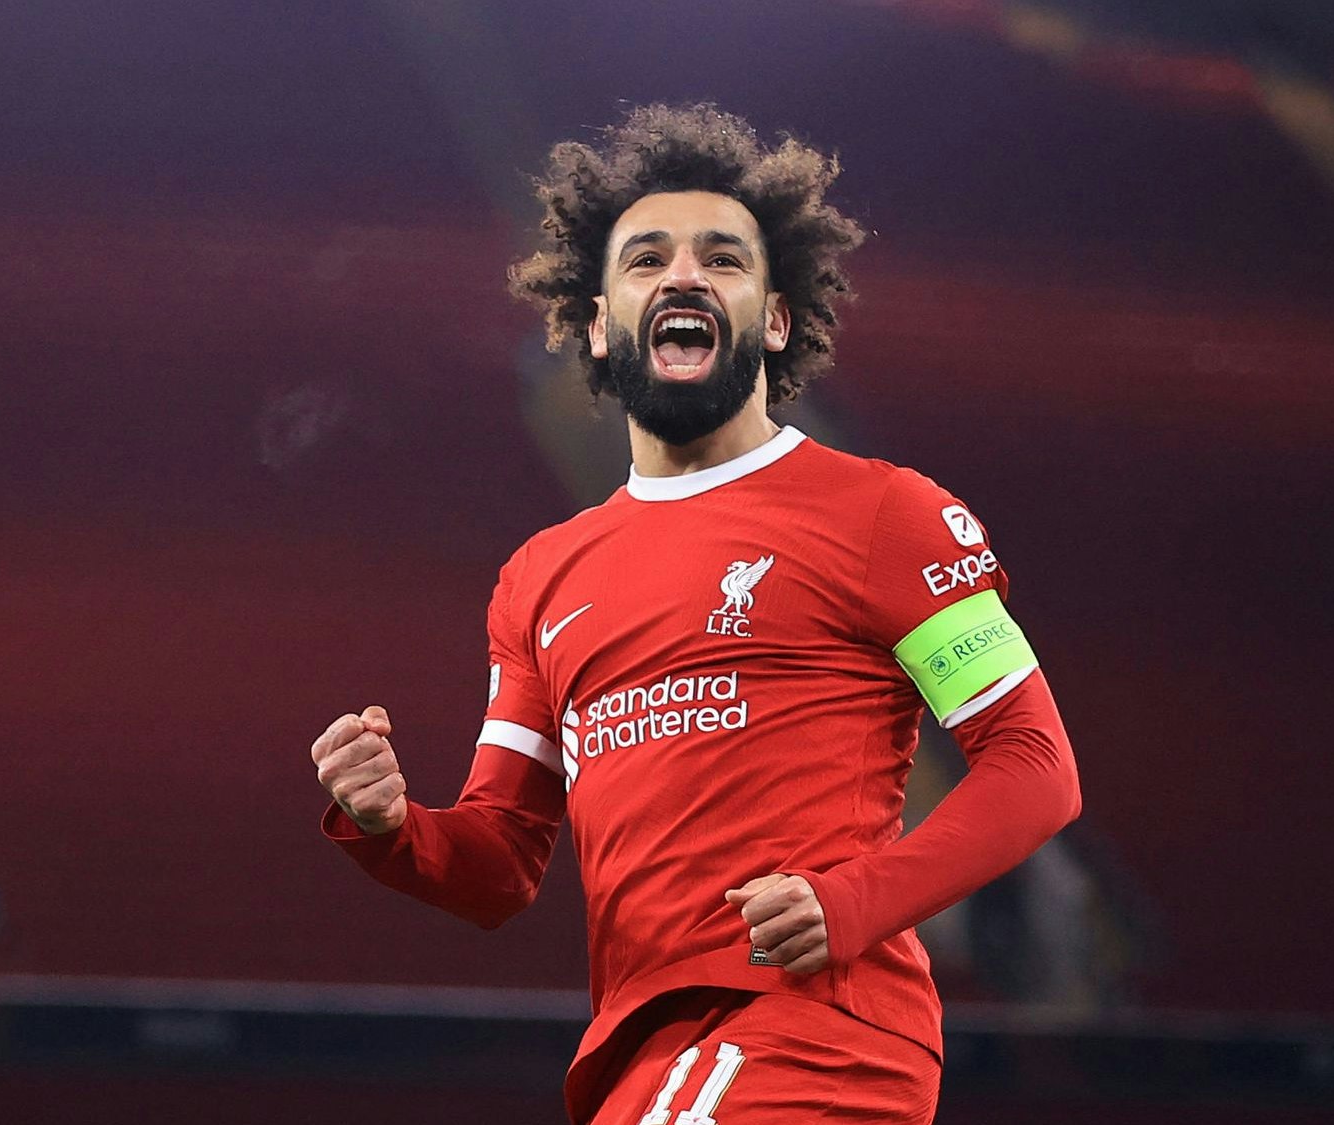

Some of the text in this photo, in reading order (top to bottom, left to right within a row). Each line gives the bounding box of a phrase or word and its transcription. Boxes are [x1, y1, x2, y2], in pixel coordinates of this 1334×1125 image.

[705, 614, 753, 638] L.F.C.
[584, 670, 739, 728] standard
[583, 700, 748, 758] chartered
